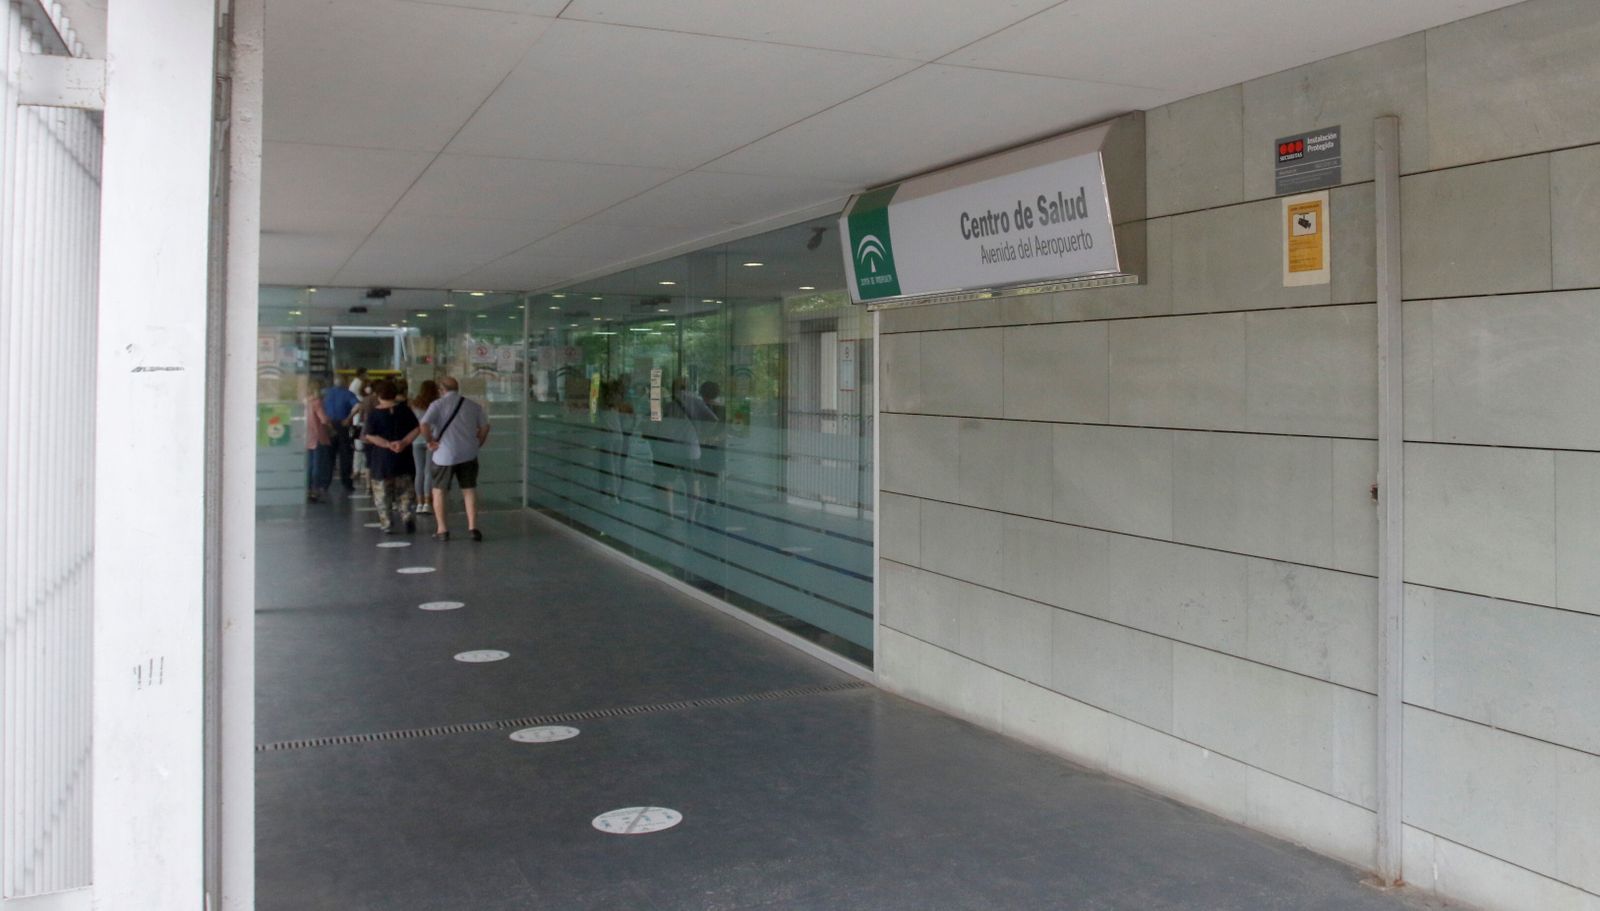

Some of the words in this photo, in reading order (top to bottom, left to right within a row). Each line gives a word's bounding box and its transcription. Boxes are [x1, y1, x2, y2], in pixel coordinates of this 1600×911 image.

[1307, 132, 1337, 144] Instalación
[1307, 141, 1334, 152] Protegida
[960, 211, 1010, 240] Centro
[1014, 199, 1034, 231] de
[1036, 186, 1089, 226] Salud
[981, 241, 1017, 265] Avenida
[1018, 236, 1034, 260] del
[1035, 229, 1094, 258] Aeropuerto
